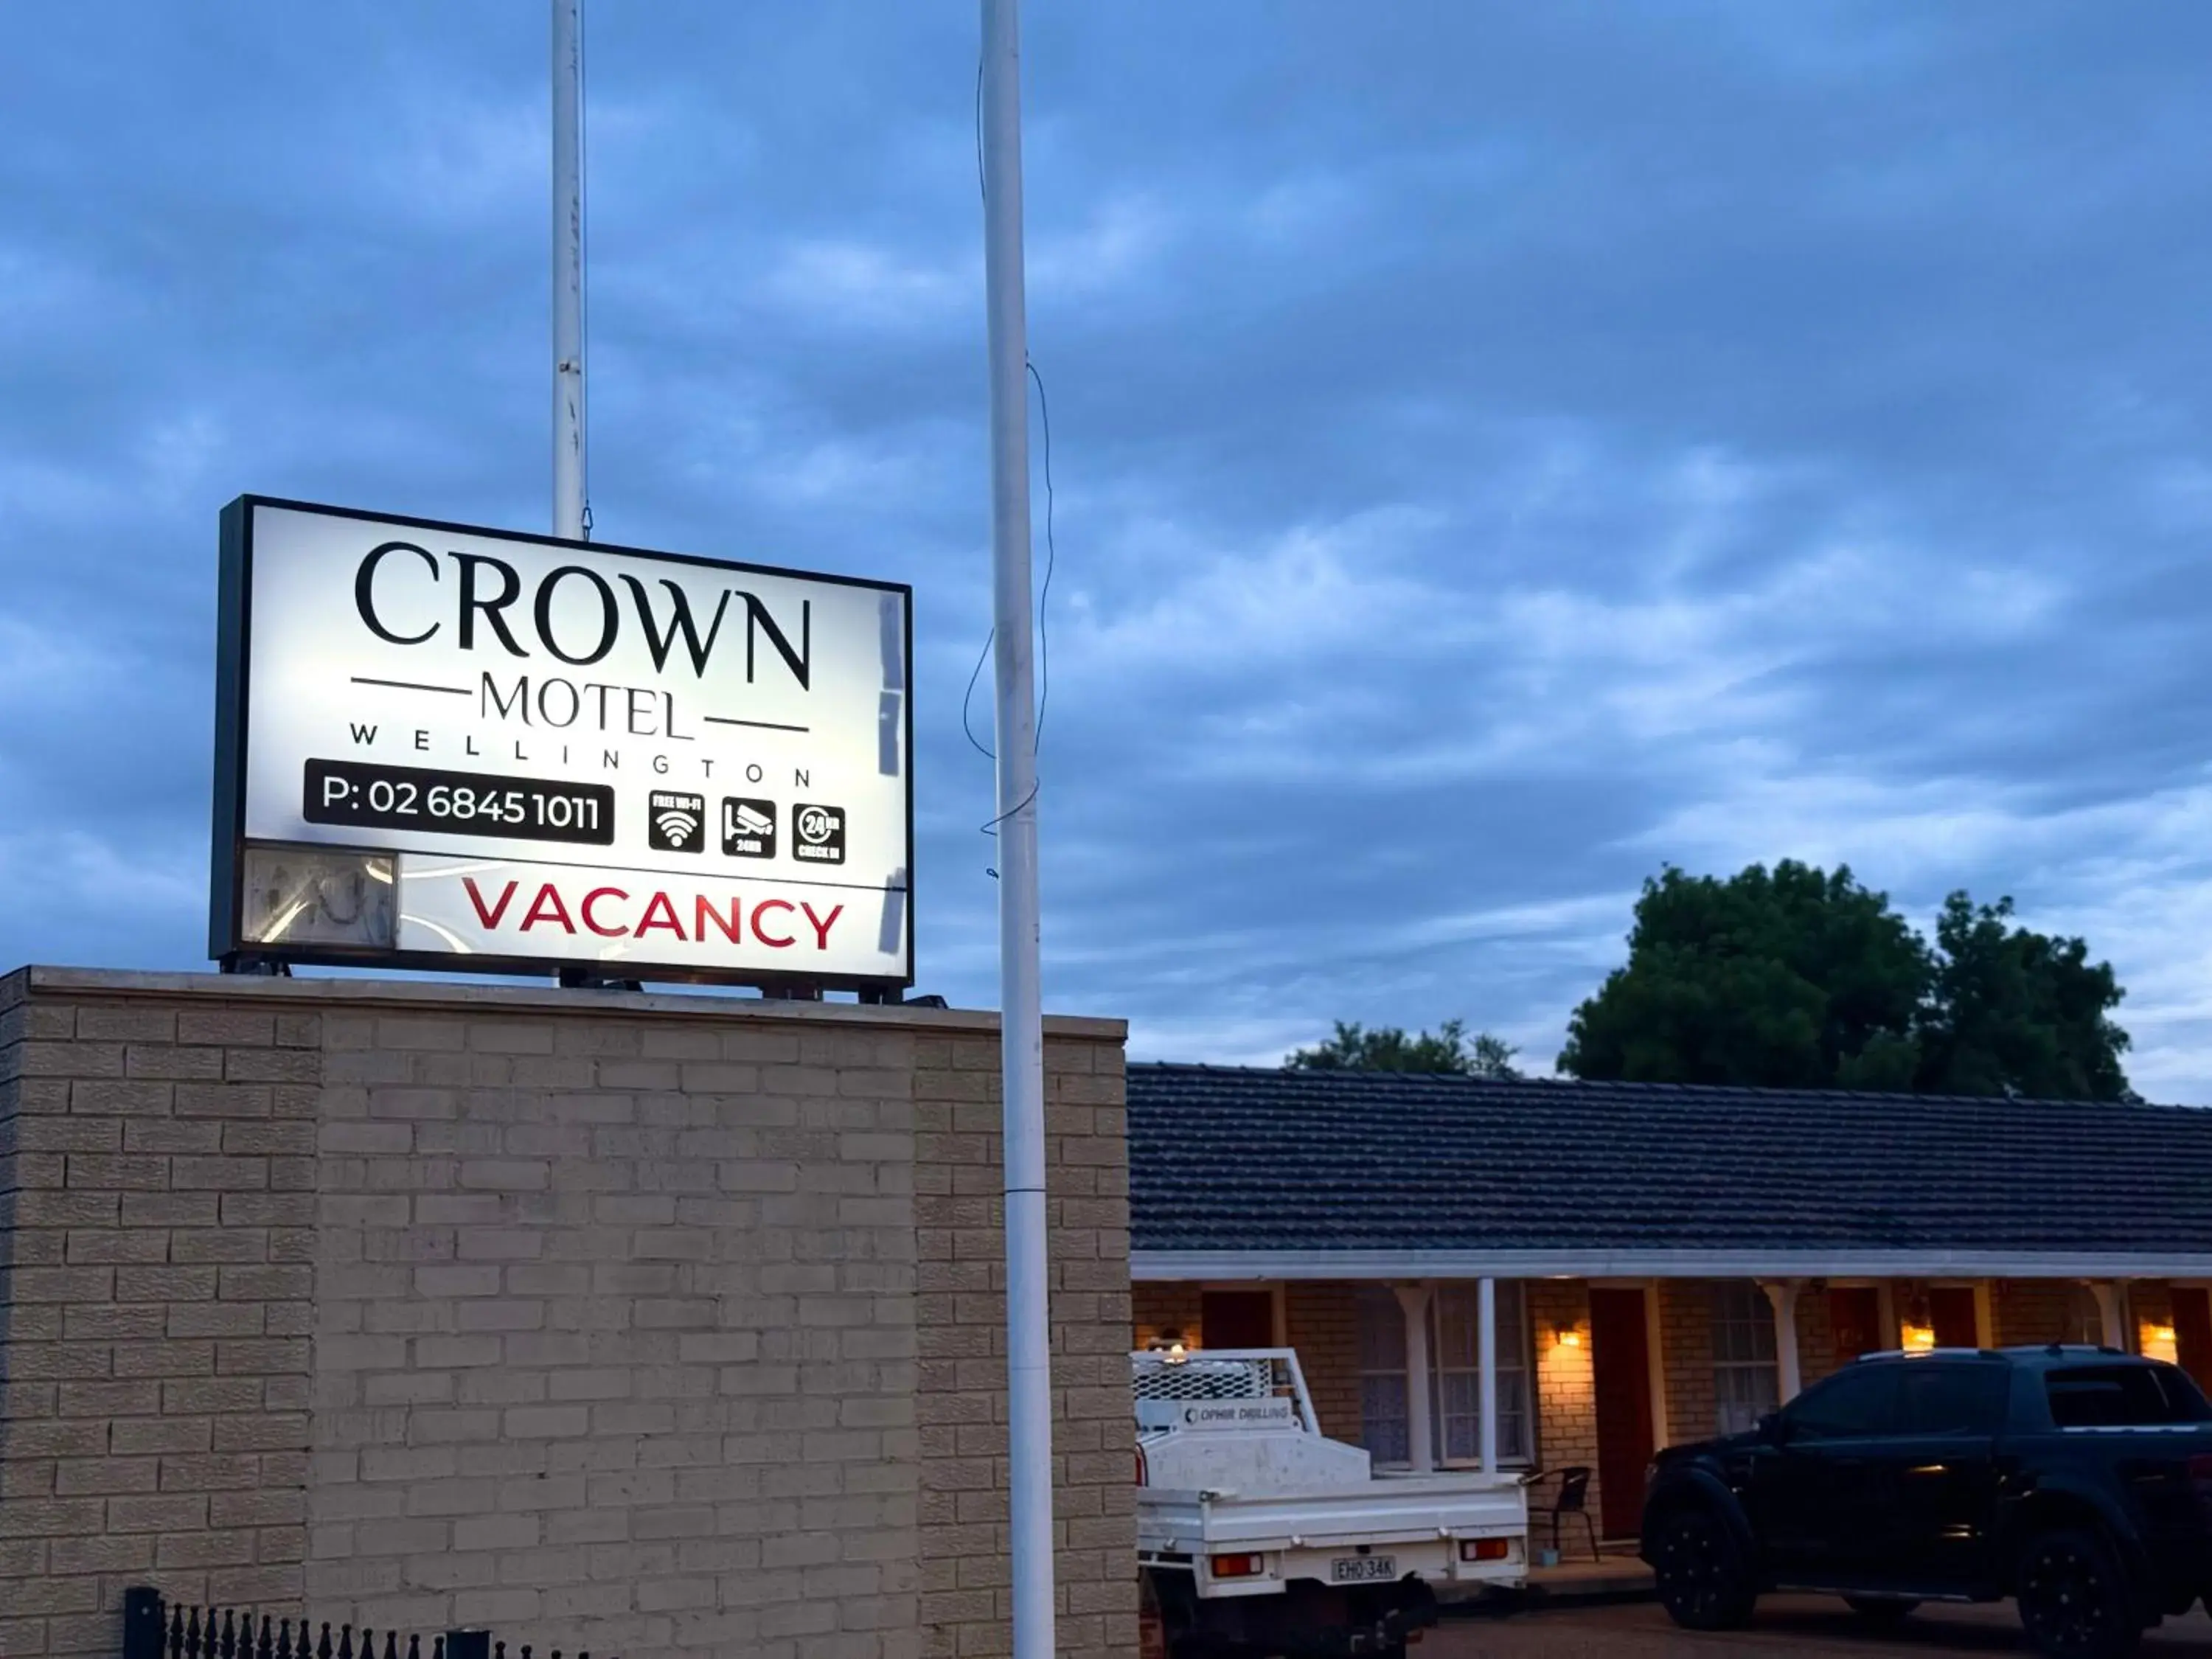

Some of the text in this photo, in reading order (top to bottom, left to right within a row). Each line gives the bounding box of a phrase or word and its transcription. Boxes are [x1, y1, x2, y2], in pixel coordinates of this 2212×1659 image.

[355, 541, 810, 691] CROWN
[481, 671, 695, 740] MOTEL
[350, 723, 810, 787] WELLINGTON
[323, 776, 598, 830] P: 02 6845 1011
[653, 795, 674, 808] FREE
[462, 877, 844, 950] VACANCY
